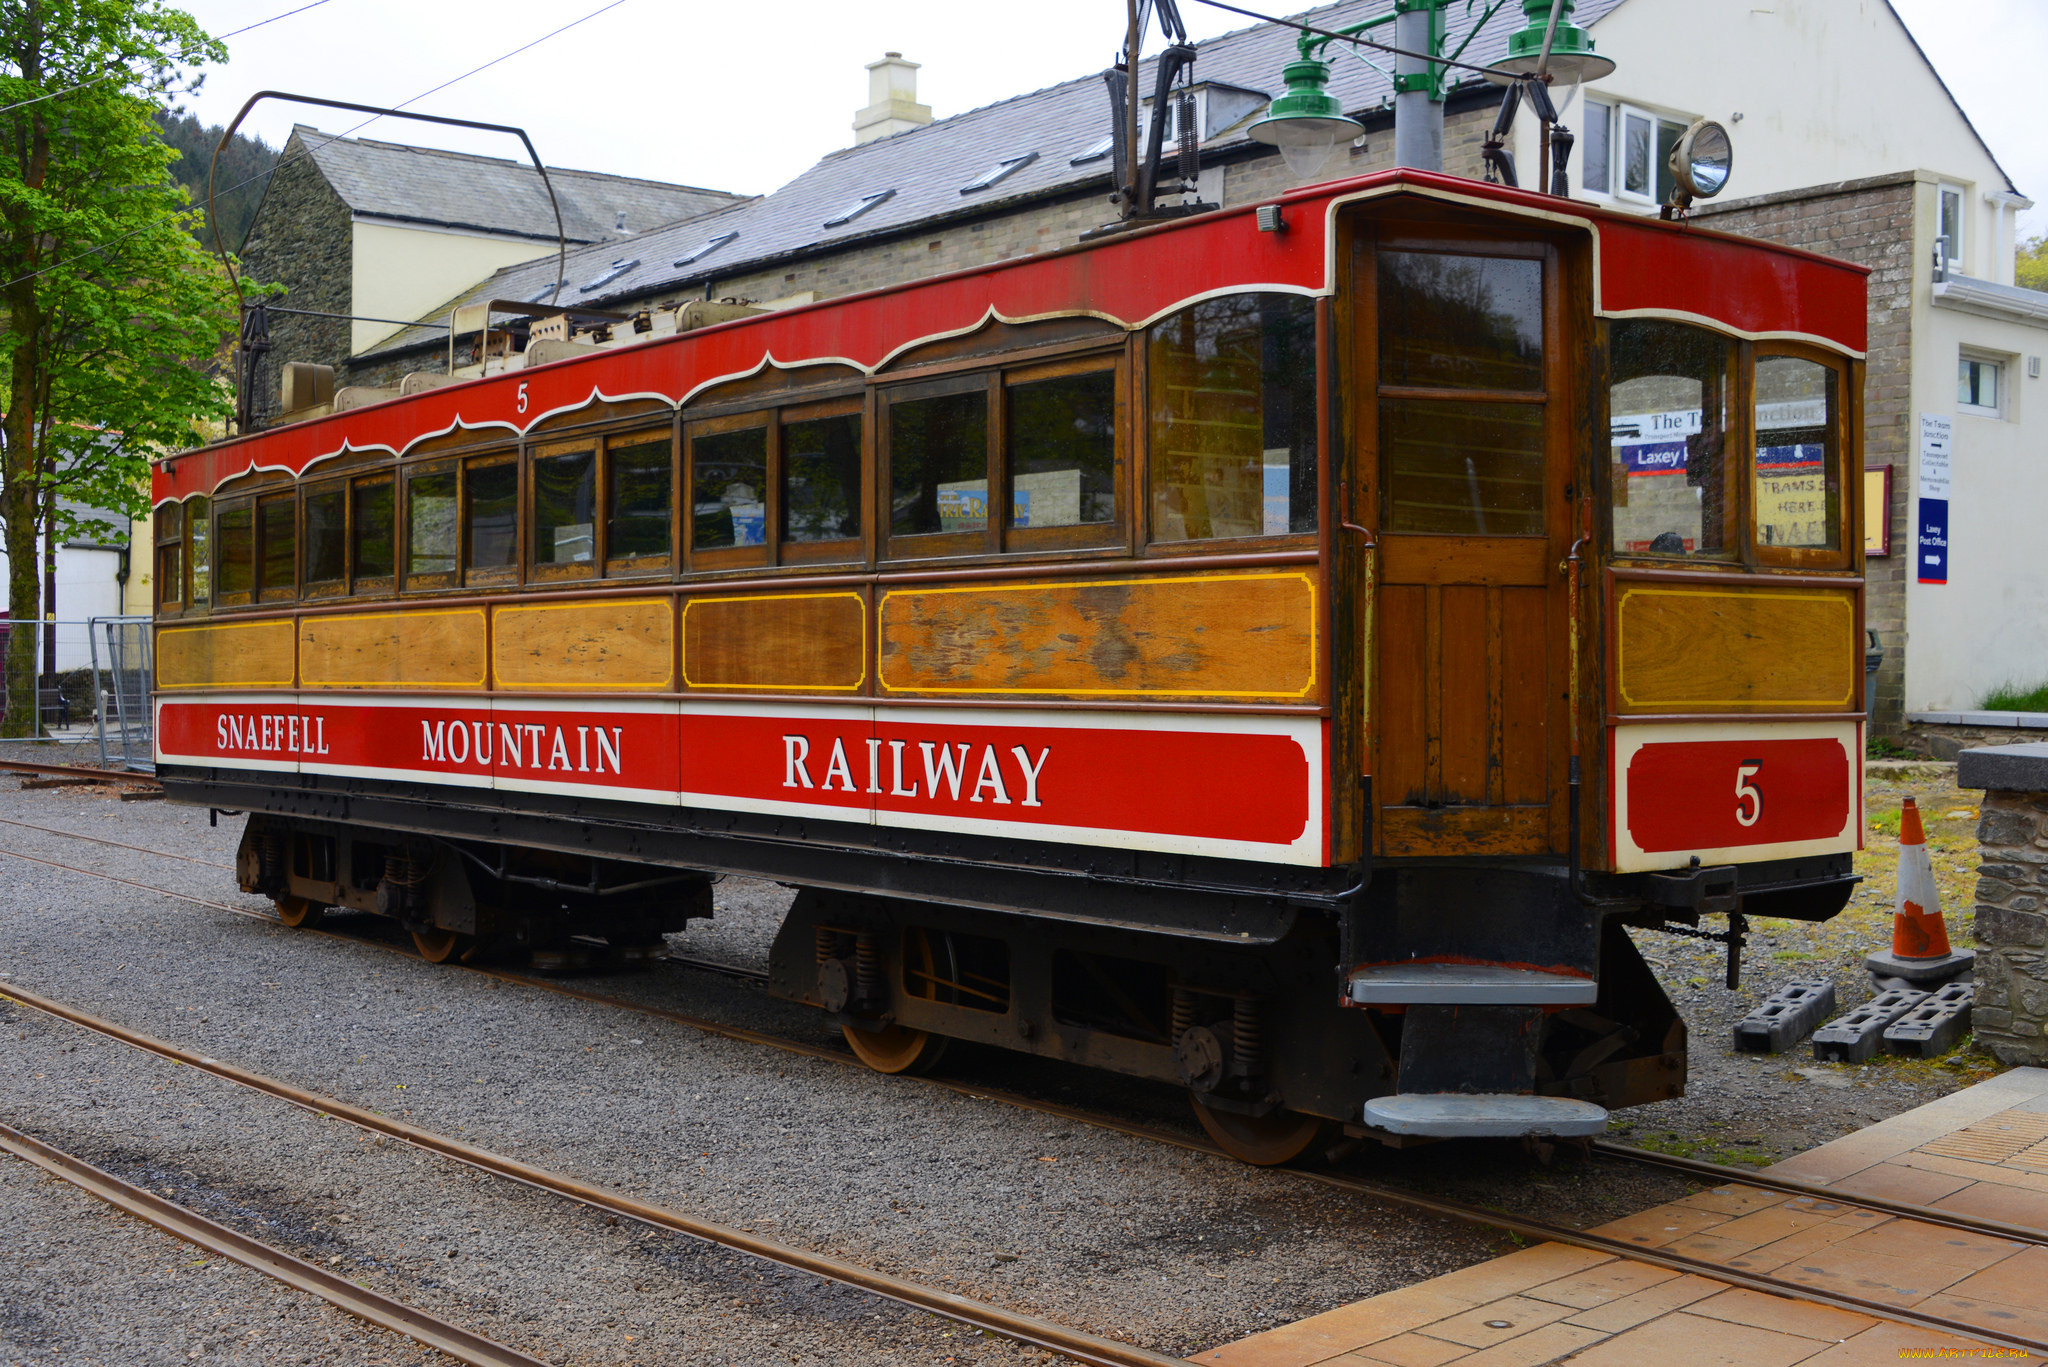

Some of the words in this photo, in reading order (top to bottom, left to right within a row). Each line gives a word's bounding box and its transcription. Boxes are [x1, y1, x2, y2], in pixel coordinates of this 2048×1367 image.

[517, 381, 529, 414] 5
[1651, 414, 1682, 430] The
[1638, 448, 1680, 467] Laxey
[1763, 480, 1816, 494] TRAMS
[1926, 524, 1941, 536] Laxey
[1920, 535, 1932, 546] Post
[1932, 537, 1947, 547] Office
[217, 714, 329, 755] SNAEFELL
[422, 720, 622, 774] MOUNTAIN
[782, 735, 1050, 807] RAILWAY
[1735, 760, 1763, 827] 5
